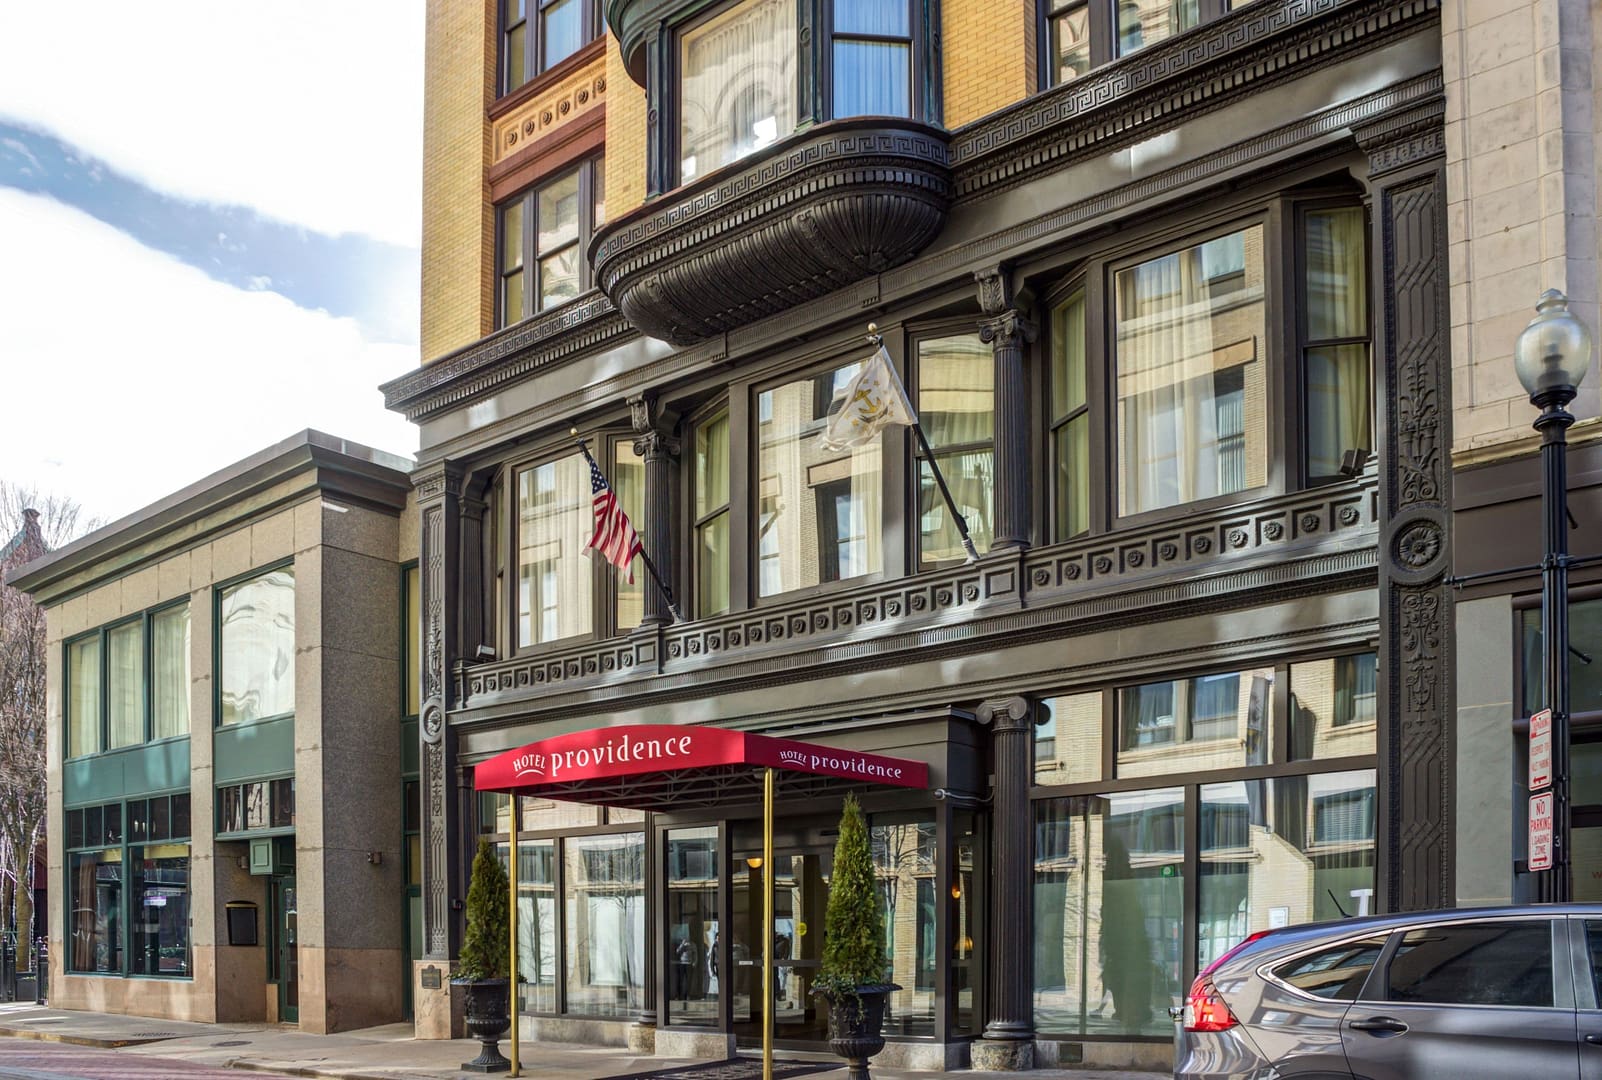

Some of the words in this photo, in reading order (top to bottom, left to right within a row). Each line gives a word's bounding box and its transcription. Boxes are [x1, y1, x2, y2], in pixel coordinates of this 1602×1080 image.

[512, 754, 546, 772] HOTEL
[551, 734, 692, 777] providence
[780, 750, 807, 763] HOTEL
[811, 755, 902, 779] providence
[1535, 801, 1546, 815] NO
[1530, 816, 1551, 831] PARKING
